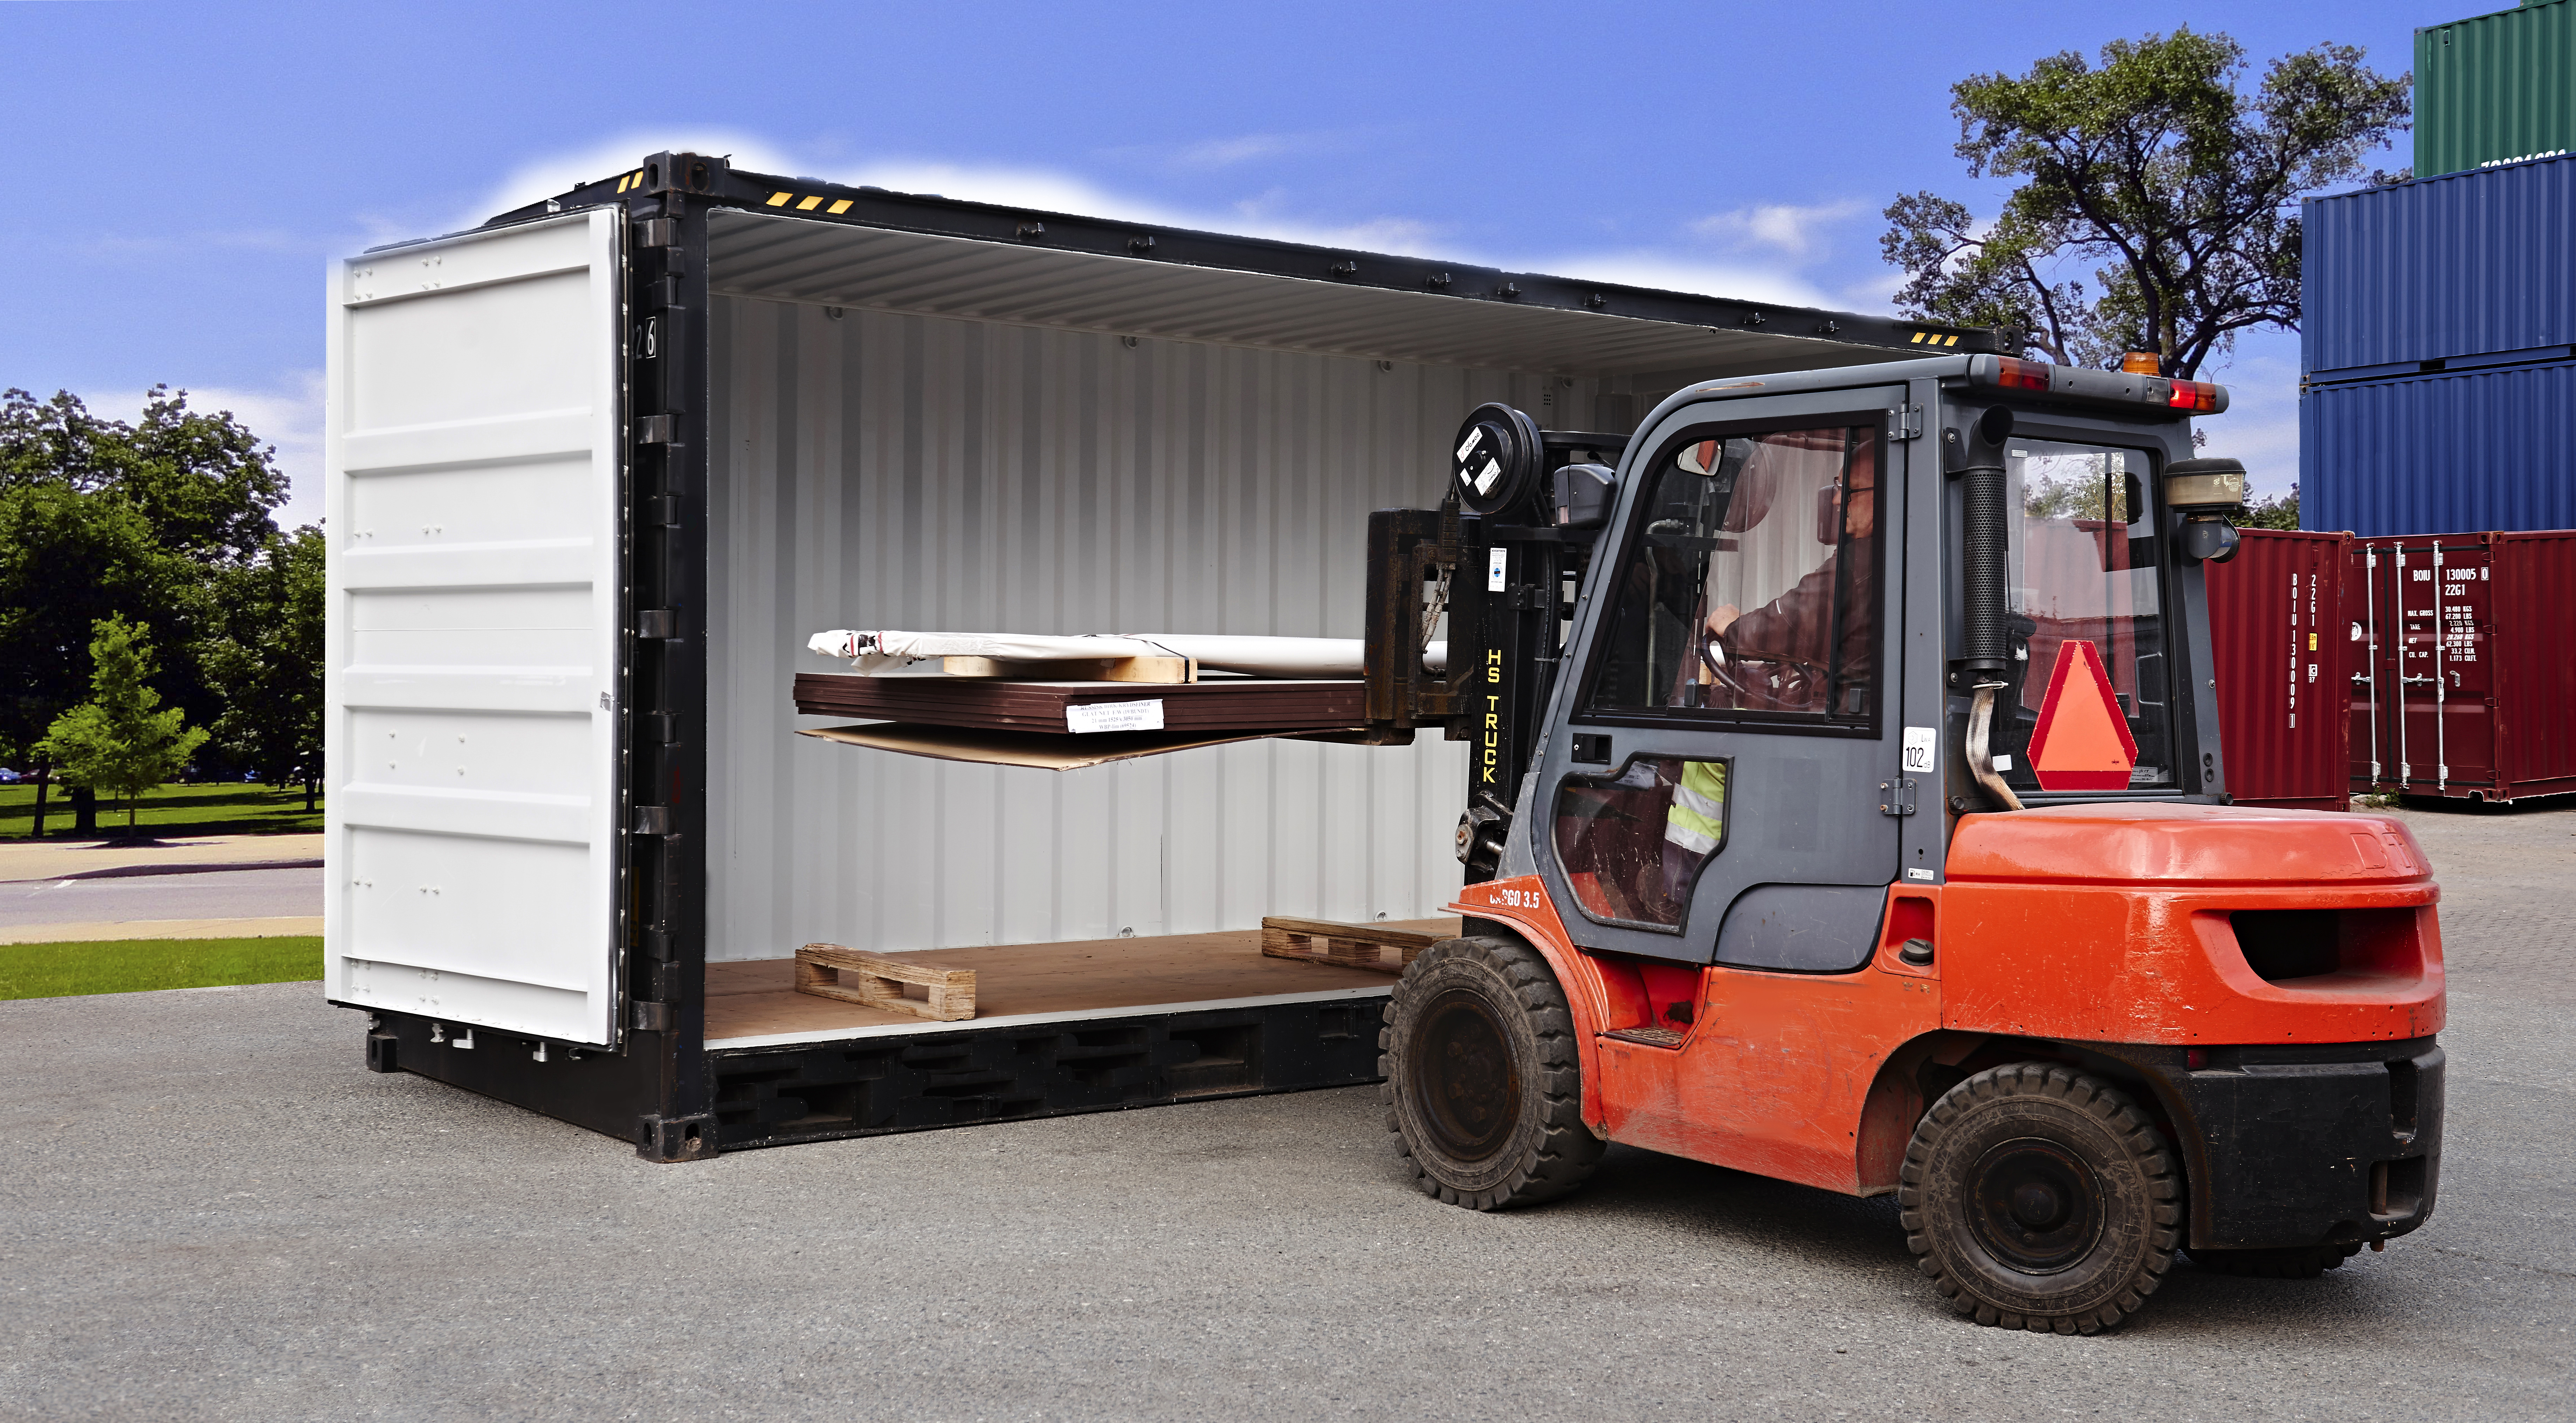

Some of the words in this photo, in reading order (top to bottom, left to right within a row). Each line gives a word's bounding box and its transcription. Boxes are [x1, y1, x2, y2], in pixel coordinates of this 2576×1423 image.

[647, 319, 655, 355] 6
[2413, 570, 2430, 581] BOIU
[2446, 568, 2476, 580] 130005
[2482, 568, 2488, 580] 0
[2445, 584, 2465, 595] 22G1
[1488, 649, 1501, 683] HS
[1483, 695, 1500, 783] TRUCK
[1906, 747, 1924, 767] 102
[1523, 891, 1539, 909] 3.5
